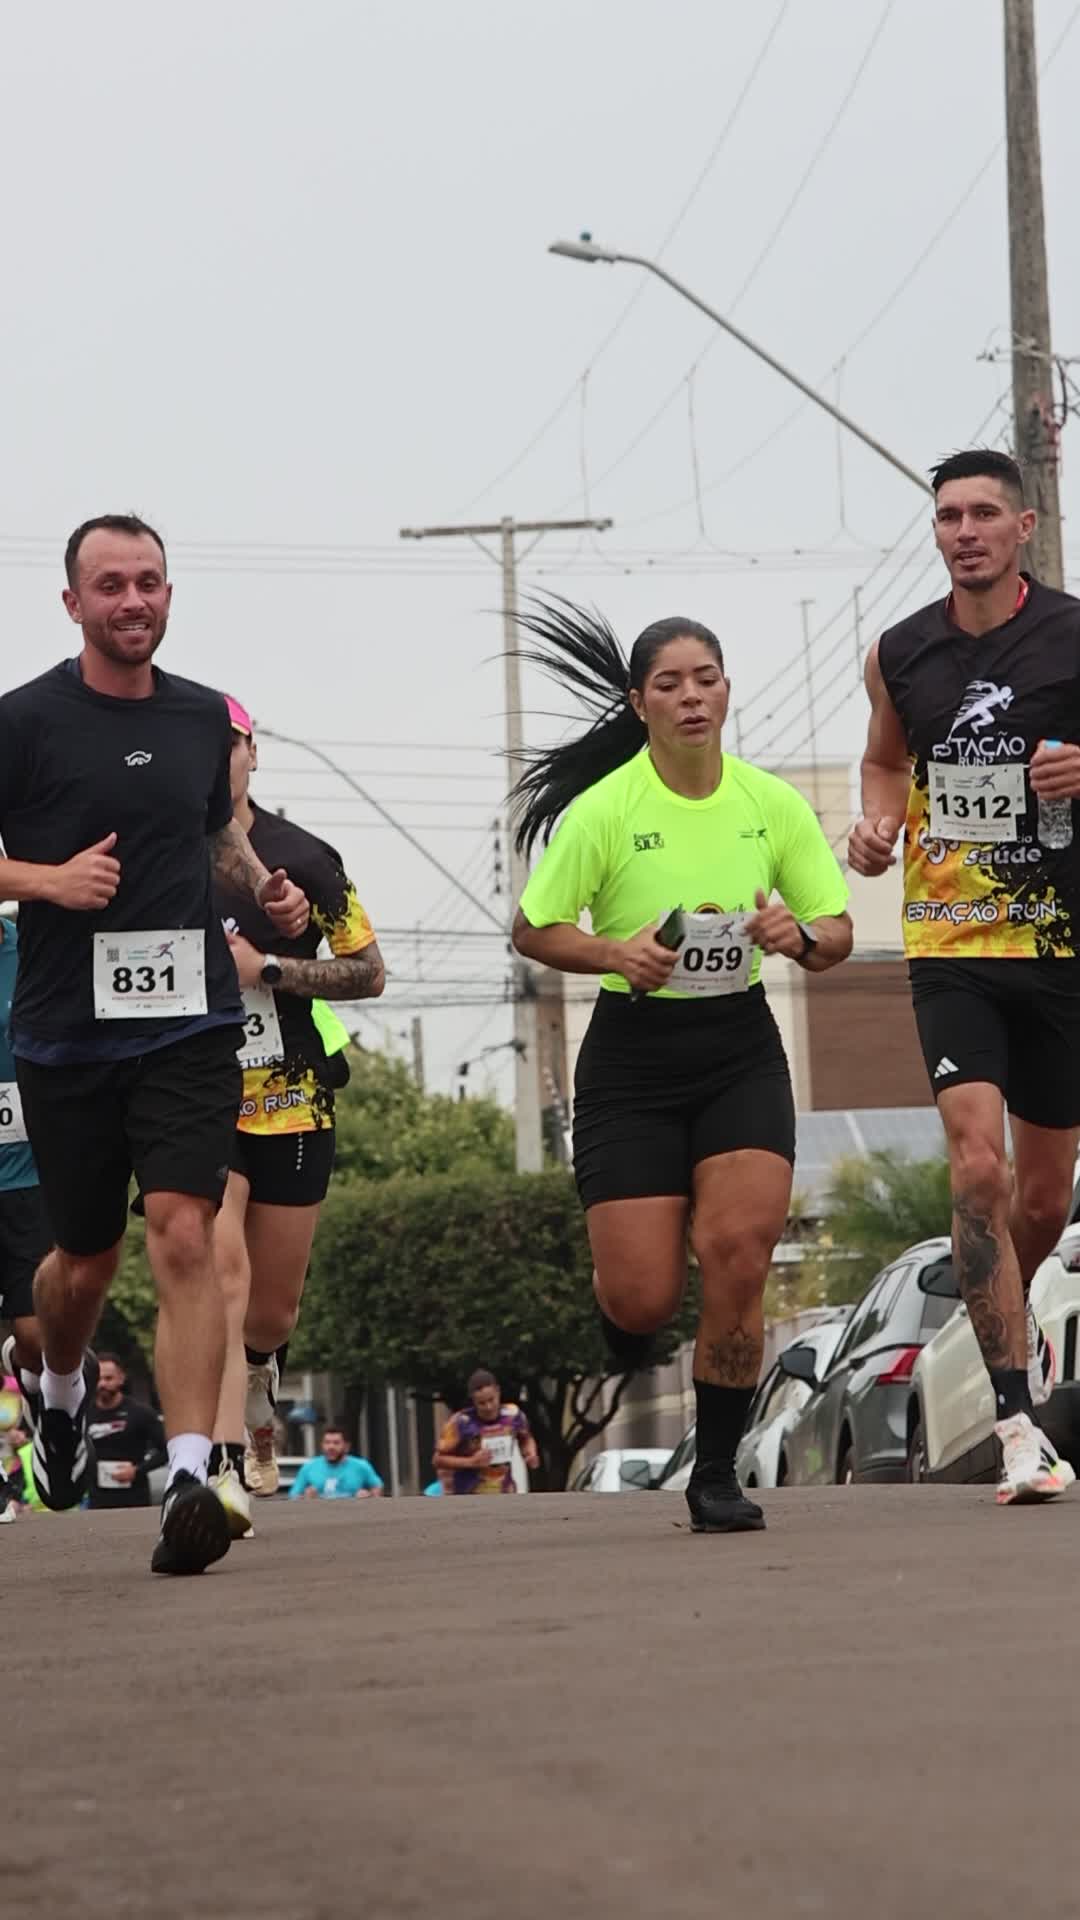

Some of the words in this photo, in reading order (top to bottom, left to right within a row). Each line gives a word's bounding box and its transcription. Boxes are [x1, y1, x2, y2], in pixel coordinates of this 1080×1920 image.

[936, 793, 1011, 819] 1312
[907, 901, 998, 925] ESTAÇÃO
[1008, 900, 1057, 920] RUN
[683, 946, 743, 972] 059
[112, 965, 174, 993] 831
[247, 1013, 265, 1037] 3
[265, 1090, 307, 1113] RUN
[0, 1107, 13, 1126] 0
